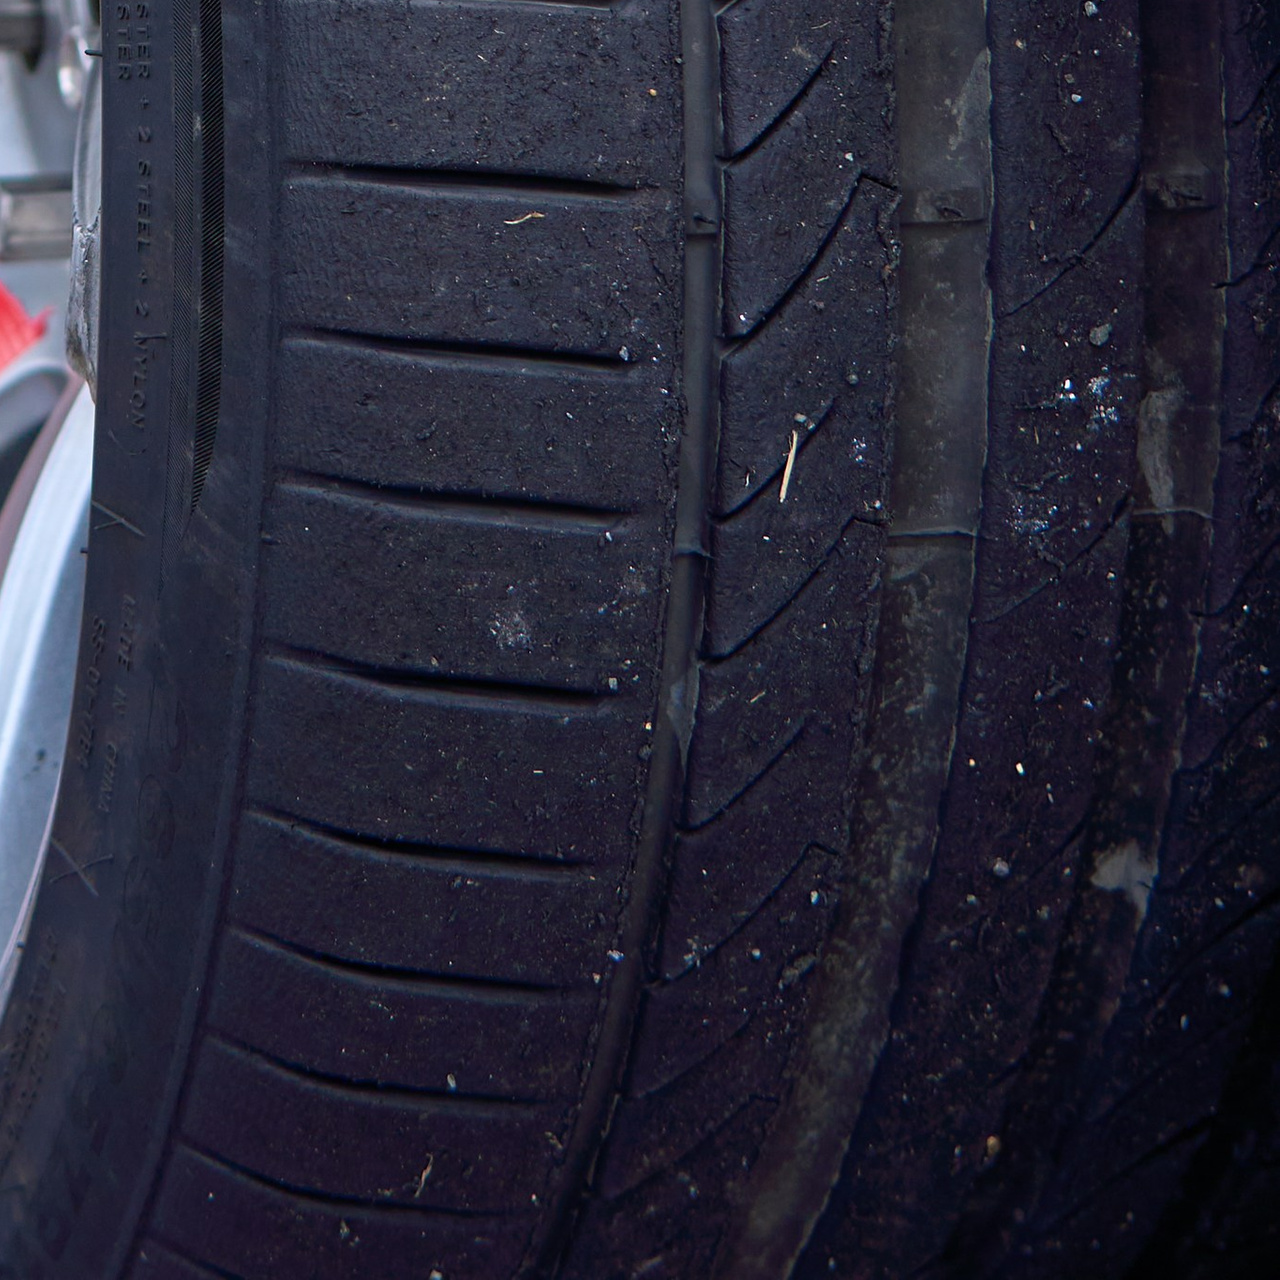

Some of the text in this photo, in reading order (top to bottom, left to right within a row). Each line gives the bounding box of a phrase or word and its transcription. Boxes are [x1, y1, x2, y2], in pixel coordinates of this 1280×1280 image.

[138, 125, 151, 142] 2
[137, 159, 152, 253] STEEL
[135, 301, 148, 318] 2
[130, 334, 147, 431] NYLON
